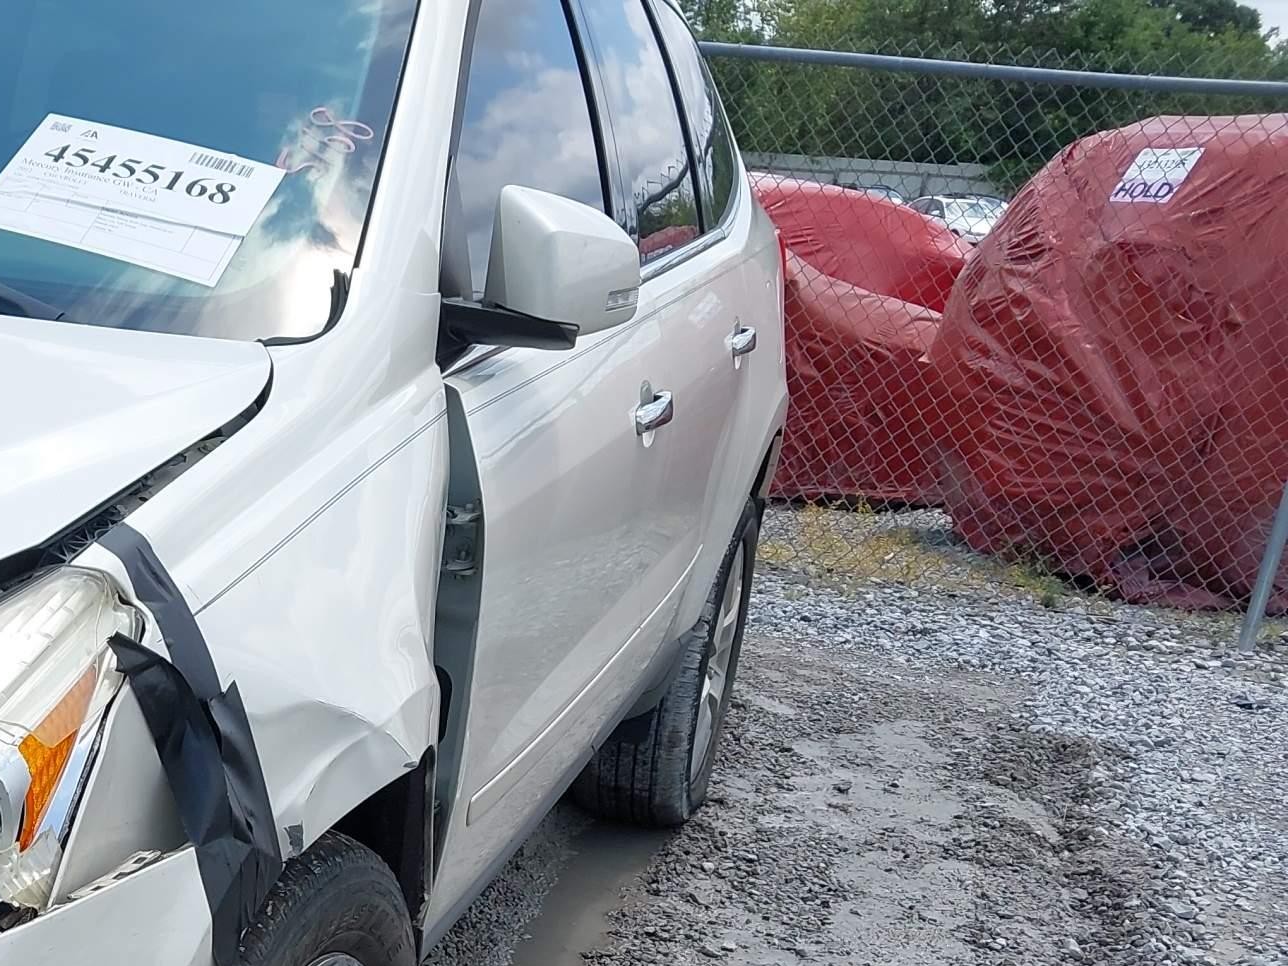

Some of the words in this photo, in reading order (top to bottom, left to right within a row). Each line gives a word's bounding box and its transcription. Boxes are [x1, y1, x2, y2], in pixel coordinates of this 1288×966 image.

[22, 156, 60, 173] Mercury
[63, 166, 112, 183] Insurance
[44, 142, 237, 205] 45455168
[1114, 182, 1174, 199] HOLD
